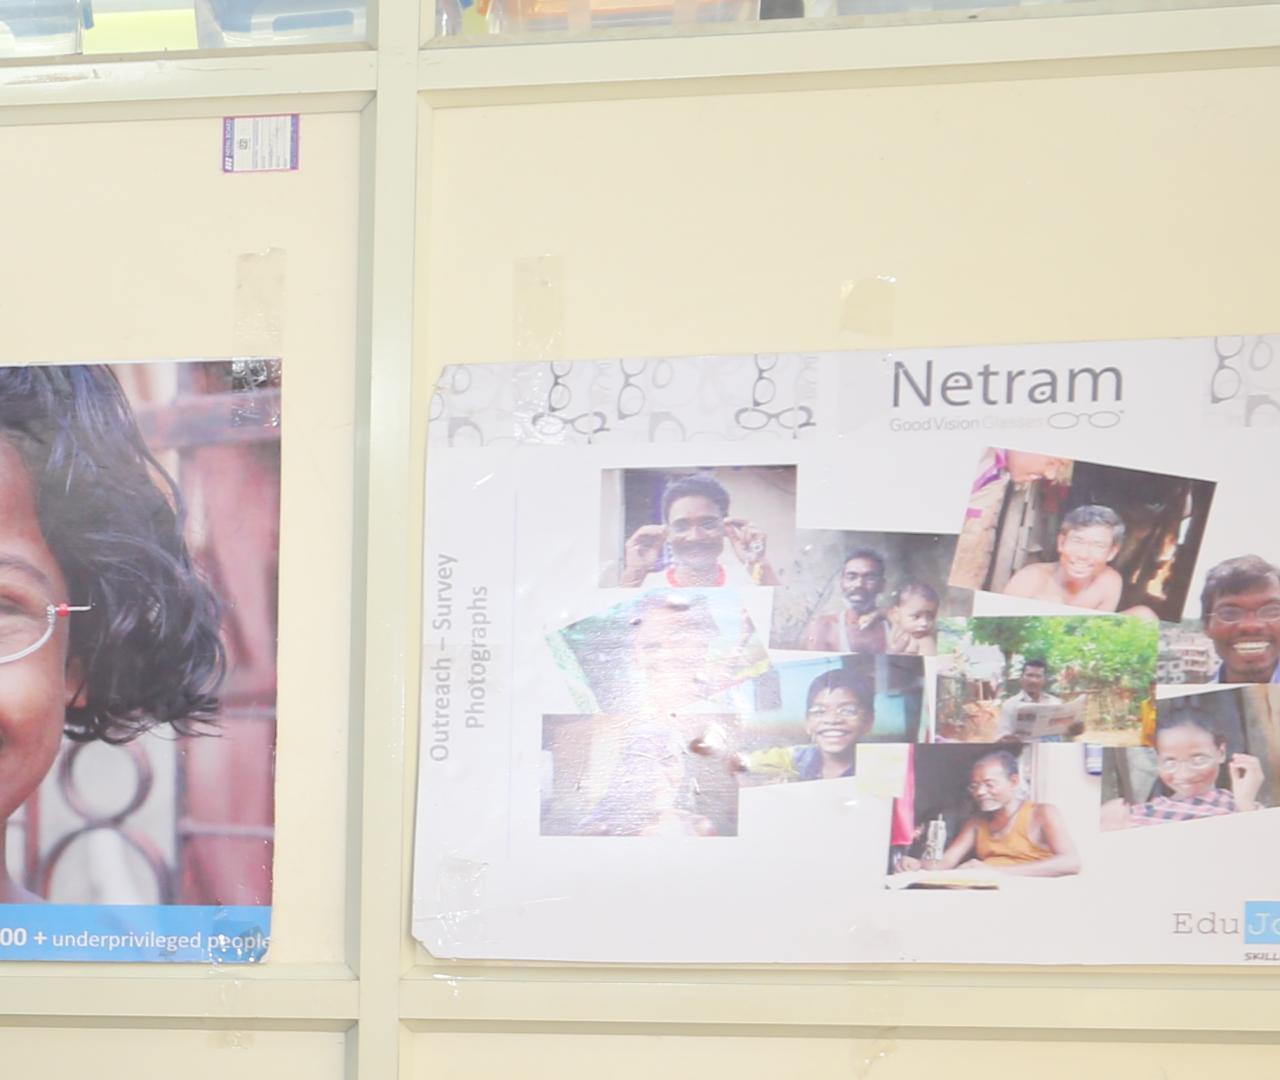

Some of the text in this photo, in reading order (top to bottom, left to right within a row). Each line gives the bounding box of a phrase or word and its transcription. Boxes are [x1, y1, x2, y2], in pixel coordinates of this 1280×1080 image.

[892, 360, 1122, 408] Netram
[432, 554, 458, 630] Survey
[464, 586, 491, 728] Photographs
[429, 657, 451, 761] Outreach
[53, 931, 201, 952] underprivileged
